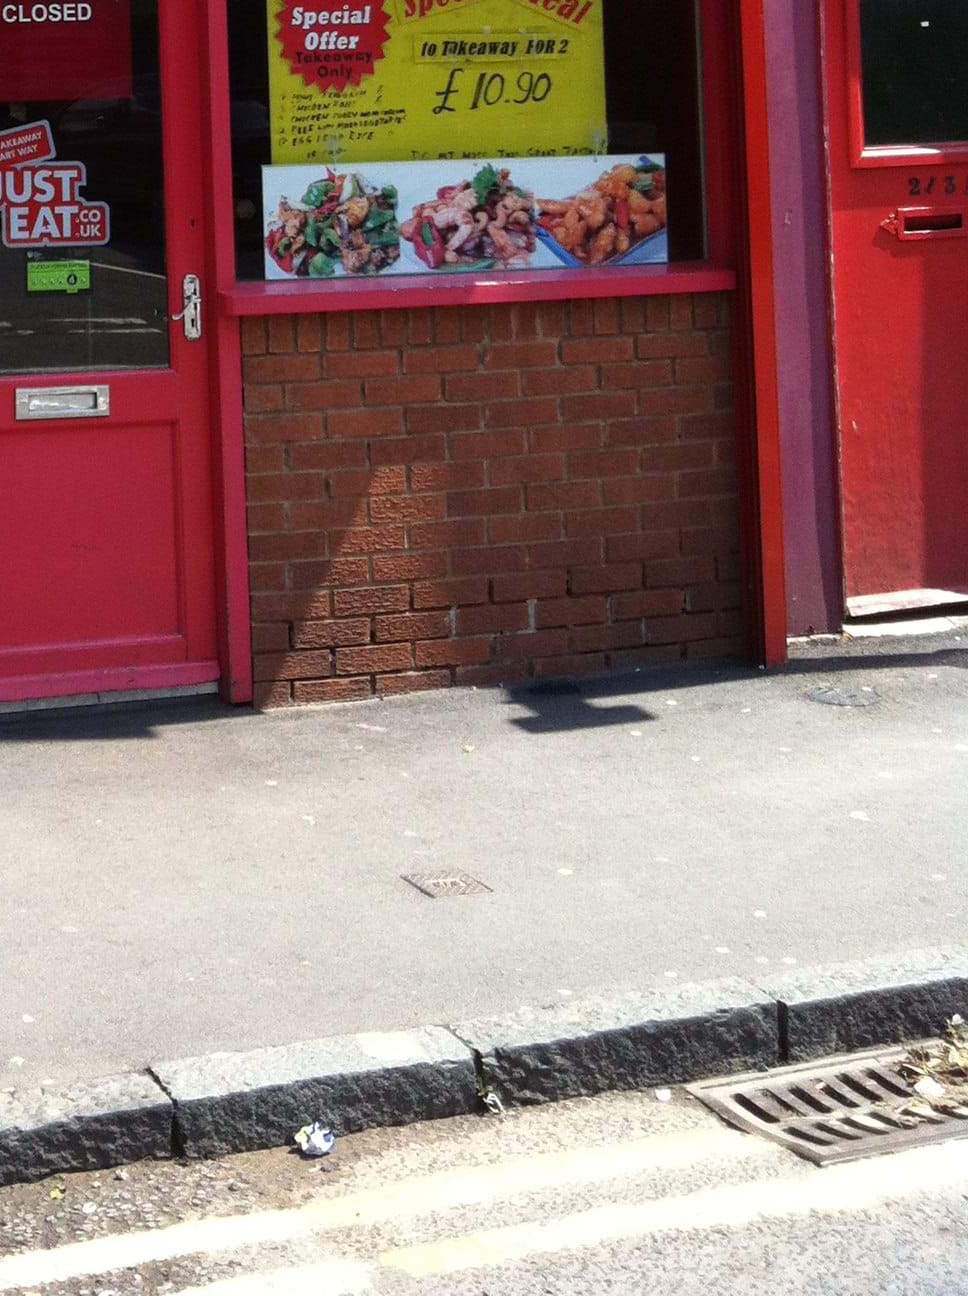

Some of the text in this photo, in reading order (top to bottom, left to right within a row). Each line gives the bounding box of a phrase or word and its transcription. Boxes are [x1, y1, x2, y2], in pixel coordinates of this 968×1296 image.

[1, 2, 93, 24] CLOSED
[291, 4, 372, 30] Special
[304, 30, 360, 51] Offer
[421, 40, 437, 57] to
[442, 39, 519, 58] Takeaway
[558, 39, 569, 54] 2
[295, 51, 373, 64] Takeaway
[317, 65, 353, 80] Only
[17, 144, 39, 157] WAY
[9, 206, 79, 240] EAT
